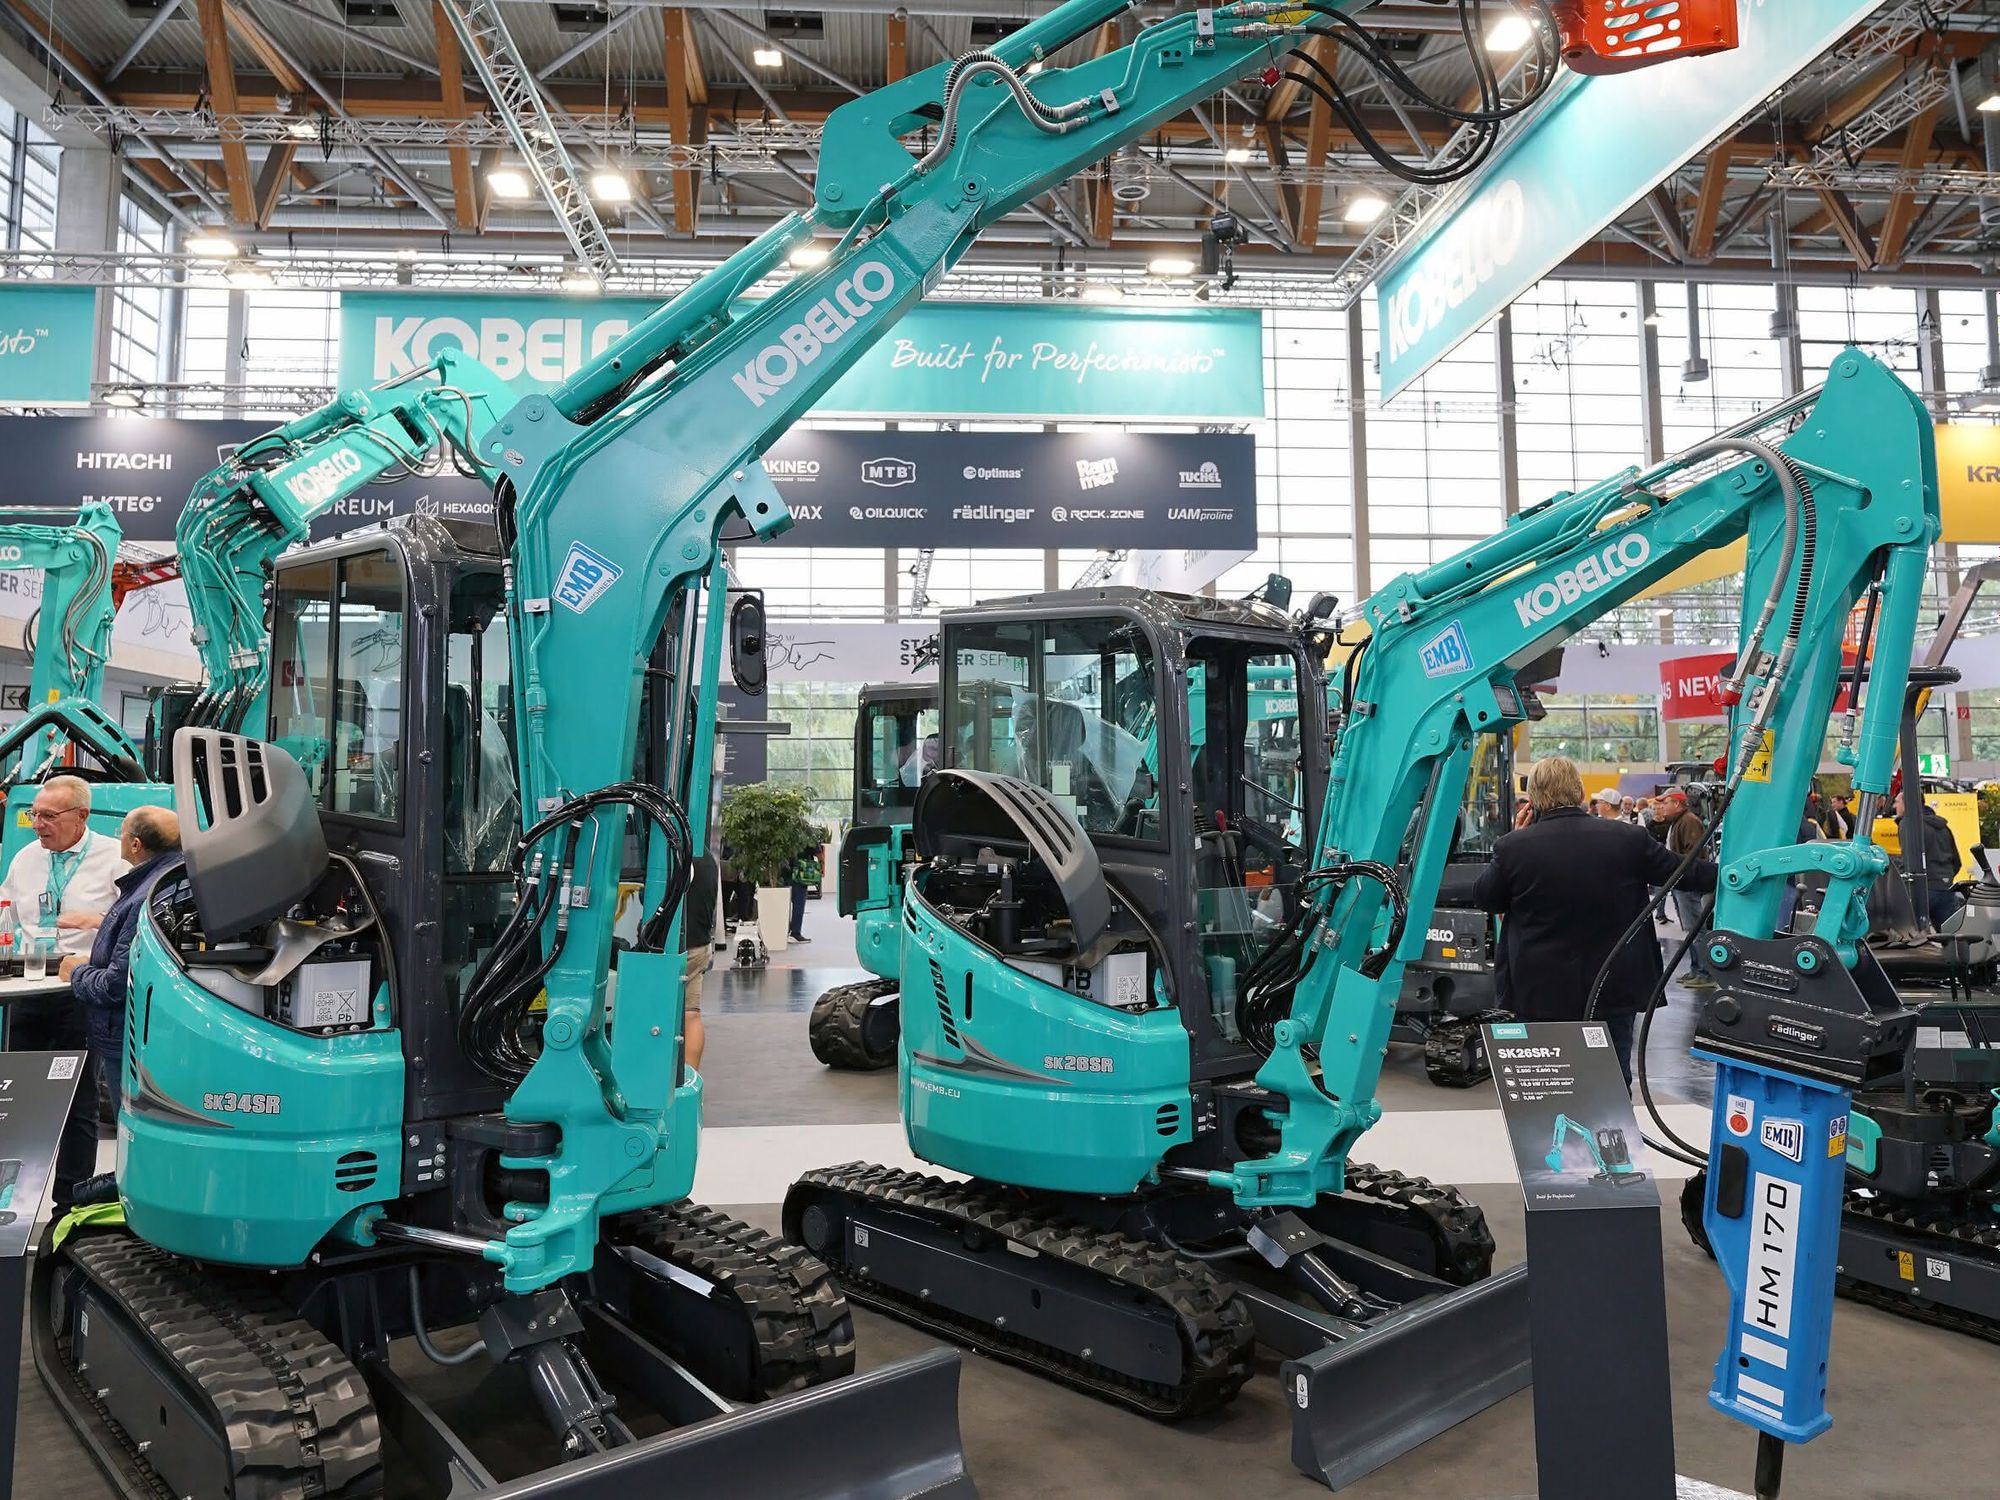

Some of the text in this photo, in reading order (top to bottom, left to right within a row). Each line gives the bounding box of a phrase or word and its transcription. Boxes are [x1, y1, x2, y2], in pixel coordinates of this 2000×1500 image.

[1388, 179, 1525, 365] KOBELCO
[731, 261, 895, 408] KOBELCO
[891, 338, 975, 369] Built
[981, 336, 1023, 384] for
[76, 452, 172, 470] HITACHI
[869, 466, 908, 479] MTB
[284, 448, 362, 505] KOBELCO
[977, 467, 1022, 481] Optimas
[1179, 471, 1222, 483] TUCHEL
[952, 505, 1035, 523] rädlinger
[1070, 510, 1145, 522] ROCK.ZONE
[559, 558, 603, 607] EMB
[1513, 533, 1650, 629] KOBELCO
[1423, 634, 1461, 670] EMB
[337, 1012, 353, 1023] Pb
[1043, 1055, 1115, 1073] SK26SR
[1497, 1047, 1561, 1059] SK26SR-7
[203, 1091, 281, 1114] SK34SR
[1764, 1125, 1794, 1149] EMB
[1756, 1182, 1788, 1329] HM 170
